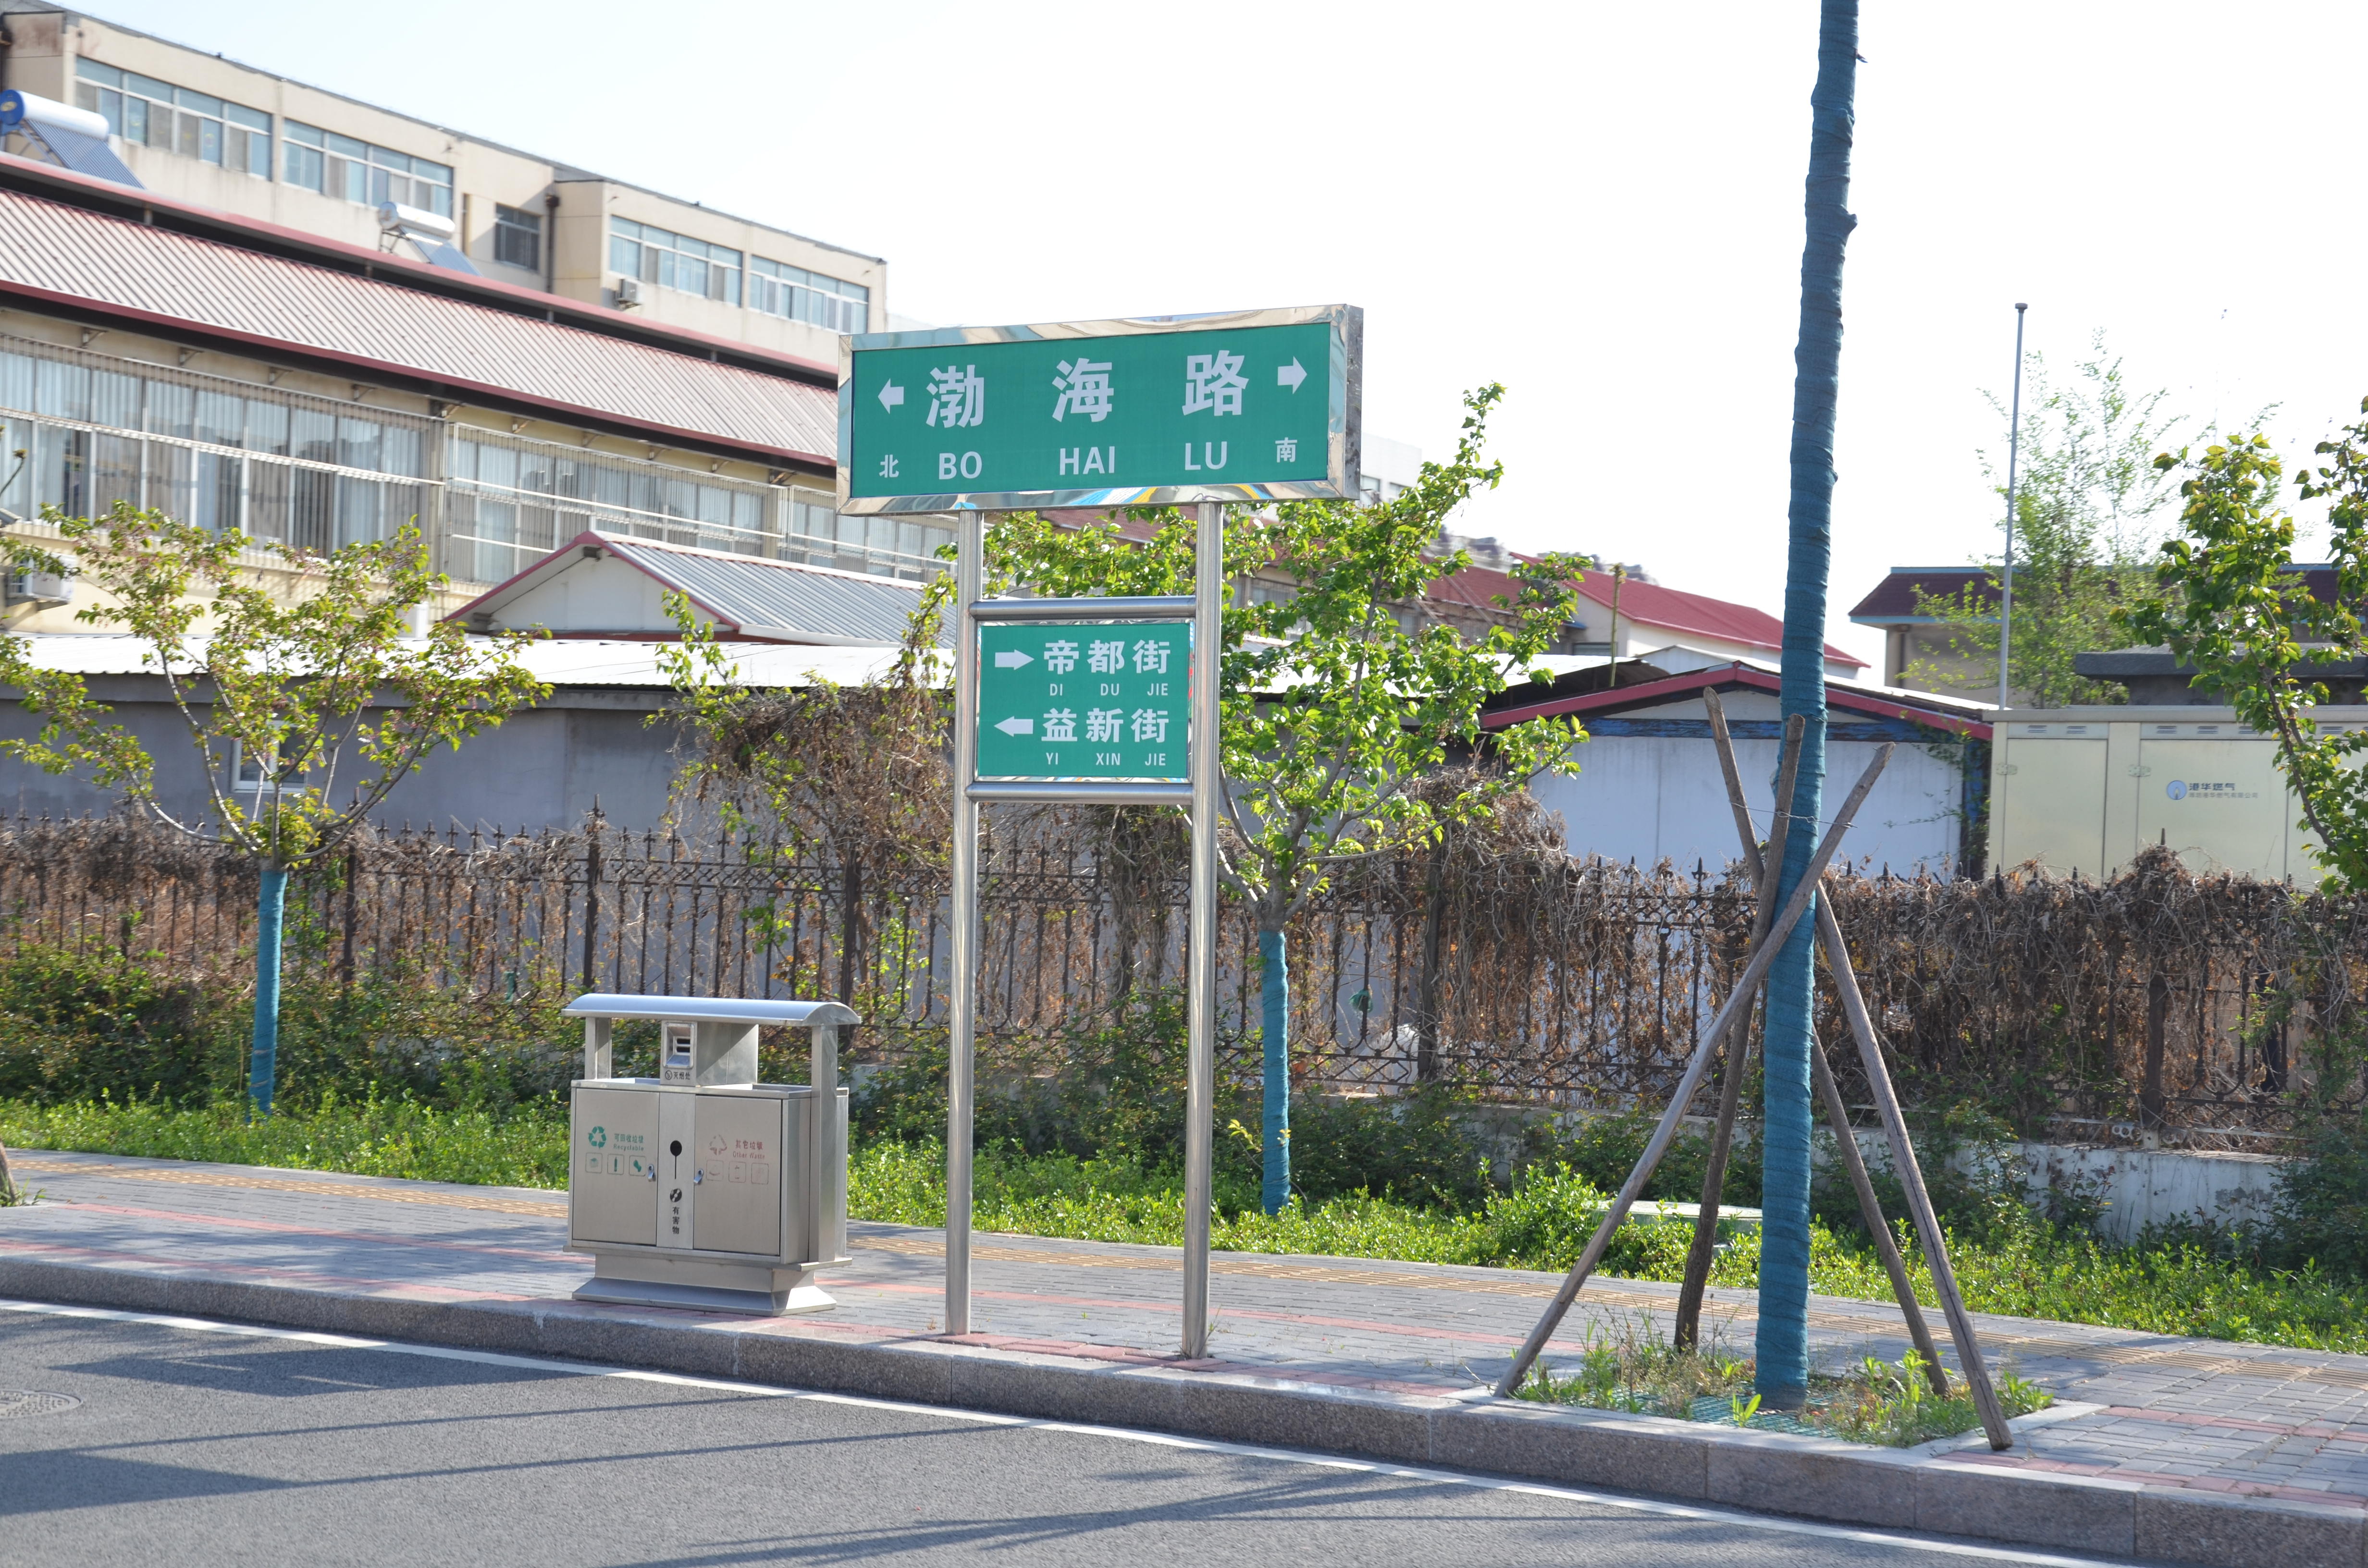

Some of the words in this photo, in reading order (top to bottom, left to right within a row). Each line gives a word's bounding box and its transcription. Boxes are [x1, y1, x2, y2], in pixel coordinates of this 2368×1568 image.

[926, 350, 1249, 428] 渤海路
[938, 451, 982, 479] BO
[1060, 446, 1115, 476] HAI
[1185, 441, 1227, 471] LU
[1275, 437, 1297, 463] 南
[879, 454, 899, 478] 北
[1044, 639, 1171, 674] 帝都街
[1049, 683, 1063, 696] DI
[1100, 683, 1120, 696] DU
[1147, 683, 1168, 696] JIE
[1041, 708, 1169, 743] 益新街
[1046, 752, 1059, 765] YI
[1096, 753, 1121, 765] XIN
[1145, 753, 1166, 766] JIE
[673, 1071, 691, 1080] 灭烟处
[613, 1143, 644, 1152] Recyclable
[614, 1133, 644, 1143] 可回收垃圾
